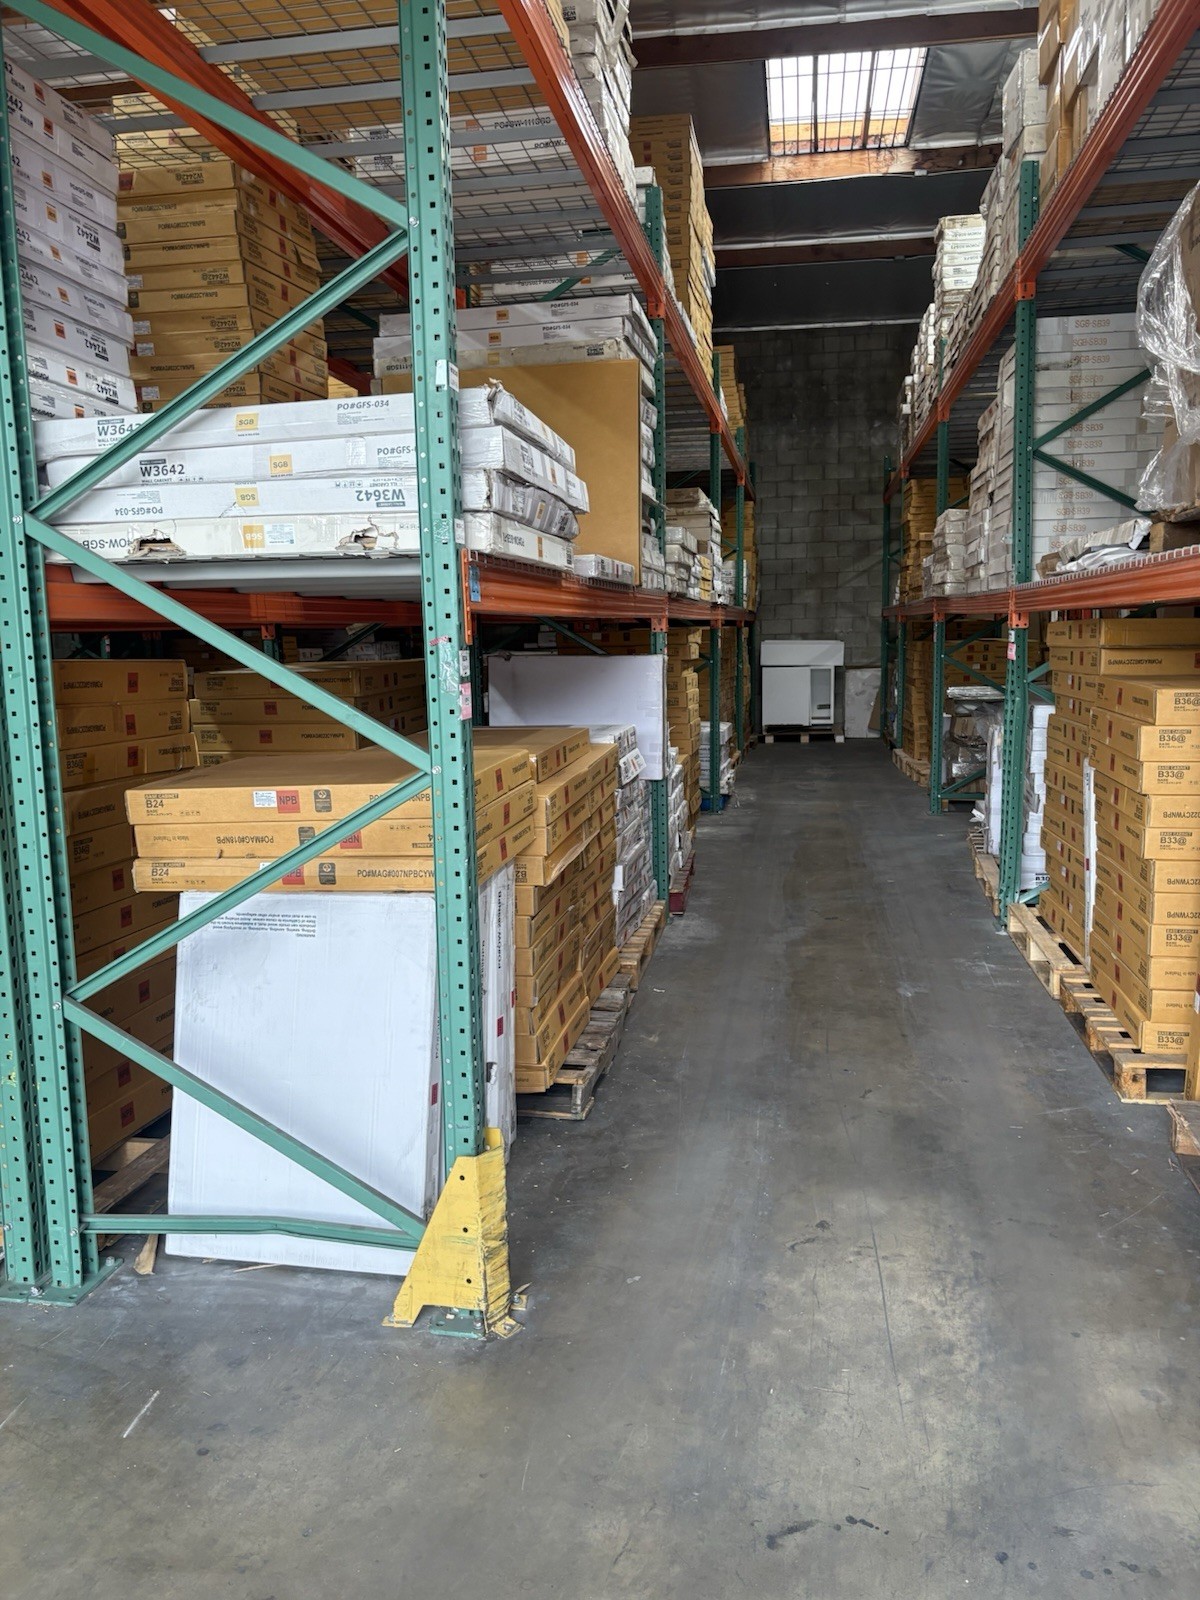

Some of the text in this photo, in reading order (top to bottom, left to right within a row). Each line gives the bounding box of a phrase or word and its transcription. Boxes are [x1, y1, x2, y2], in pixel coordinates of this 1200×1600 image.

[76, 225, 100, 245] W2442
[1075, 319, 1110, 328] SGB-SB39
[1073, 338, 1107, 346] SGB-SB39
[84, 338, 108, 356] W2442
[96, 383, 118, 399] W2442
[337, 400, 389, 410] PO#GFS-034
[1068, 441, 1102, 449] SGB-SB39
[377, 446, 417, 456] PO#GFS-
[273, 461, 288, 469] SGB
[140, 464, 185, 477] W3642
[355, 488, 405, 501] W3642
[115, 507, 164, 516] PO#GFS-034
[1159, 735, 1186, 743] B36@
[1158, 771, 1184, 779] B33@
[146, 800, 164, 808] B24
[279, 796, 298, 805] NPB
[216, 836, 274, 844] PO#MAG#018NPB
[1160, 837, 1187, 846] B33@
[151, 868, 169, 876] B24
[1166, 934, 1192, 943] B33@
[1157, 1036, 1184, 1045] B33@
